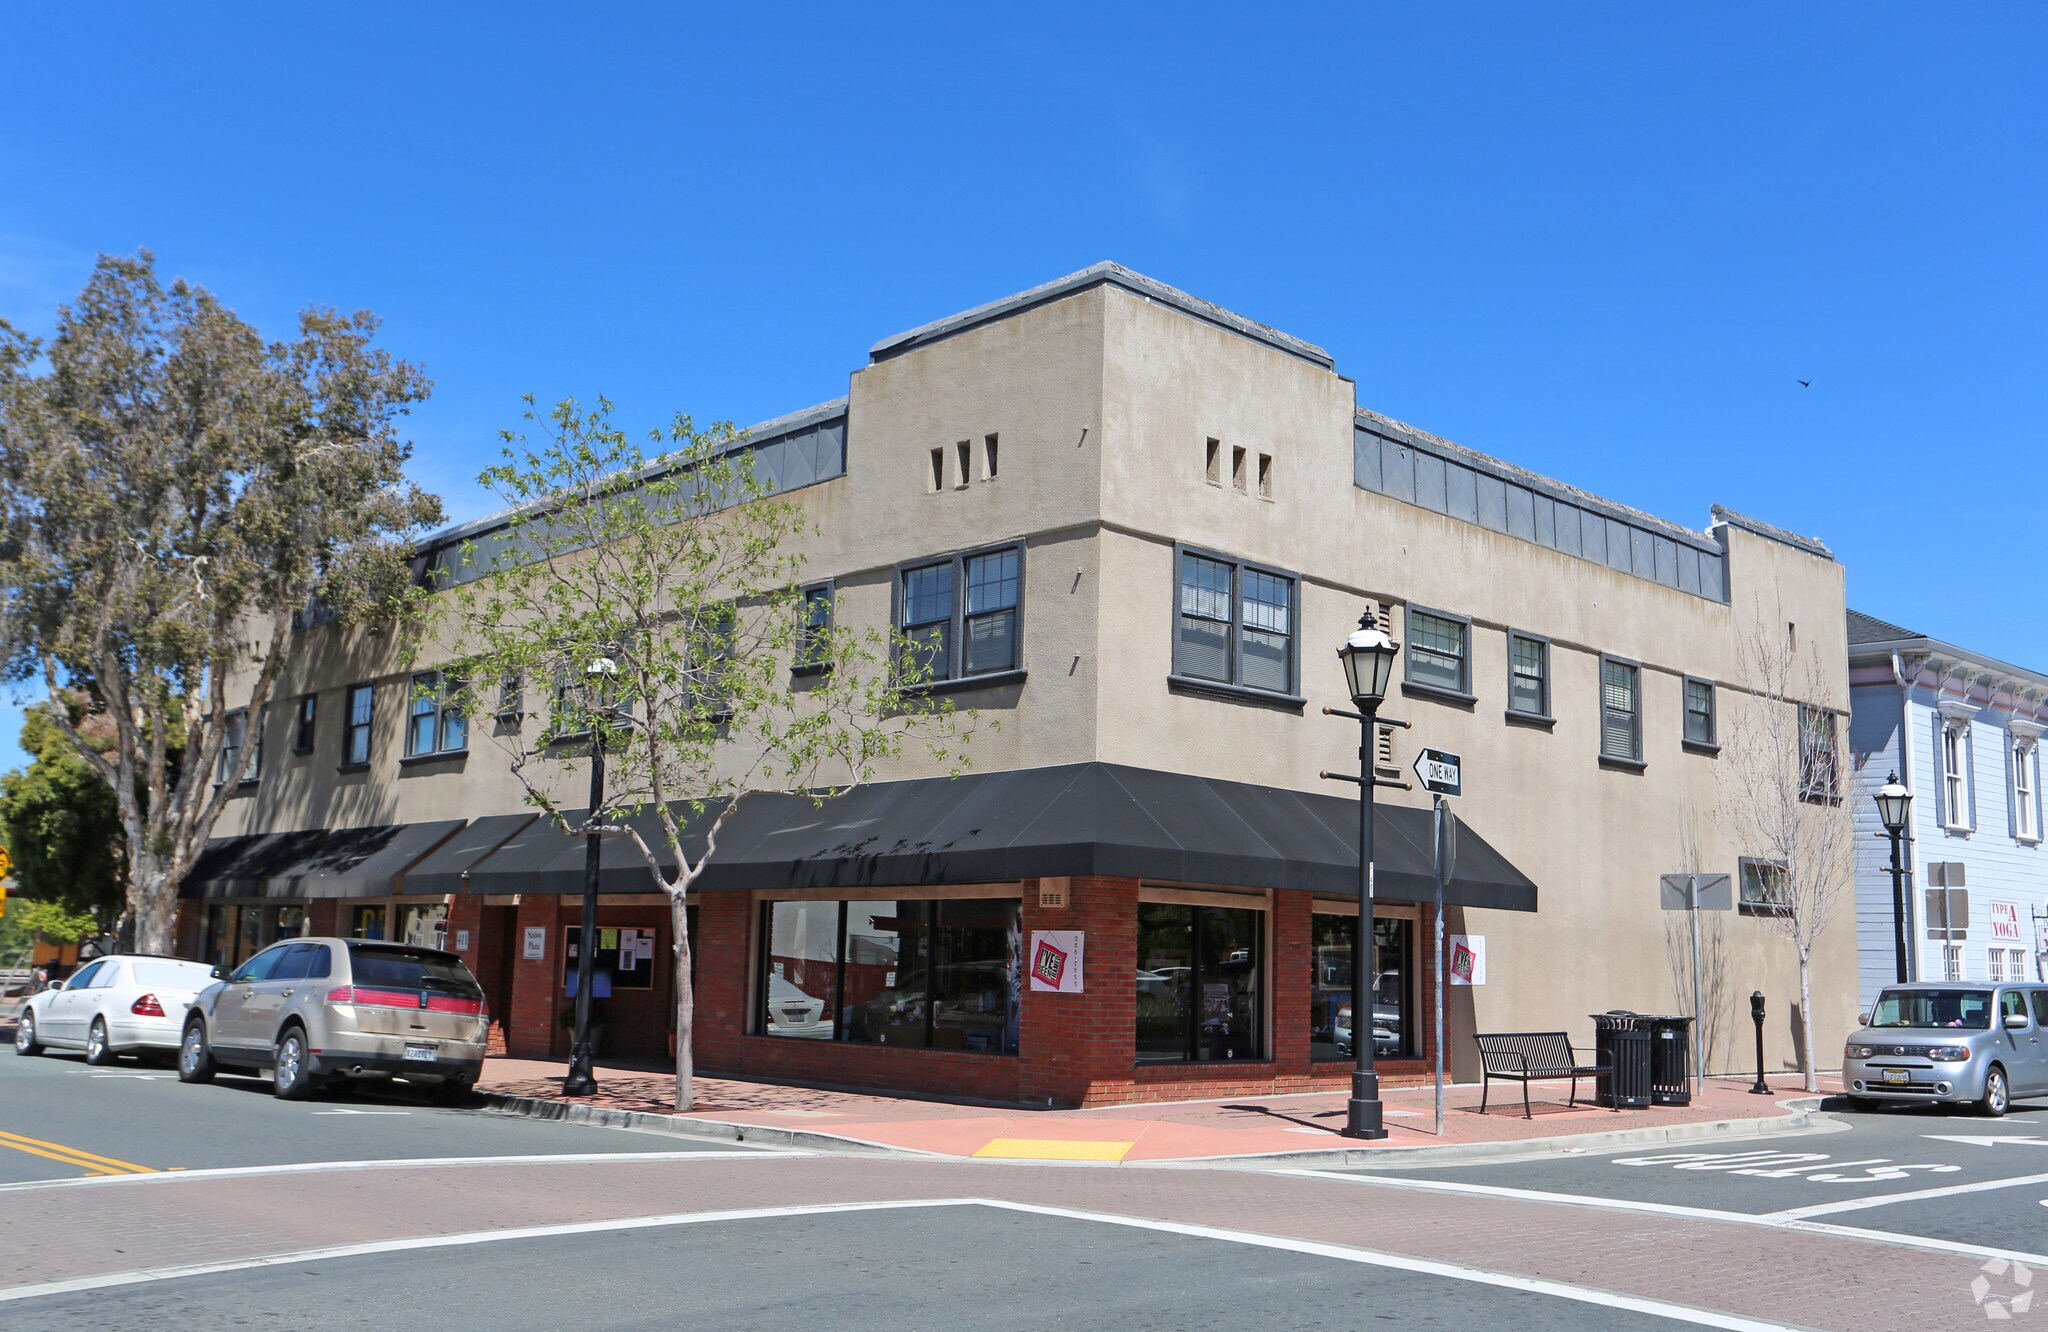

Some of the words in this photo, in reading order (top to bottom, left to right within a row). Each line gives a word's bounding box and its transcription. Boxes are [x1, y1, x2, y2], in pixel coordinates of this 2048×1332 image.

[1429, 763, 1442, 779] ONE
[1444, 765, 1456, 782] WAY
[1991, 903, 2008, 914] TYPE
[2008, 905, 2017, 922] A
[1993, 922, 2019, 938] YOGA
[1039, 948, 1056, 970] I'VE
[1038, 964, 1052, 978] BEEN
